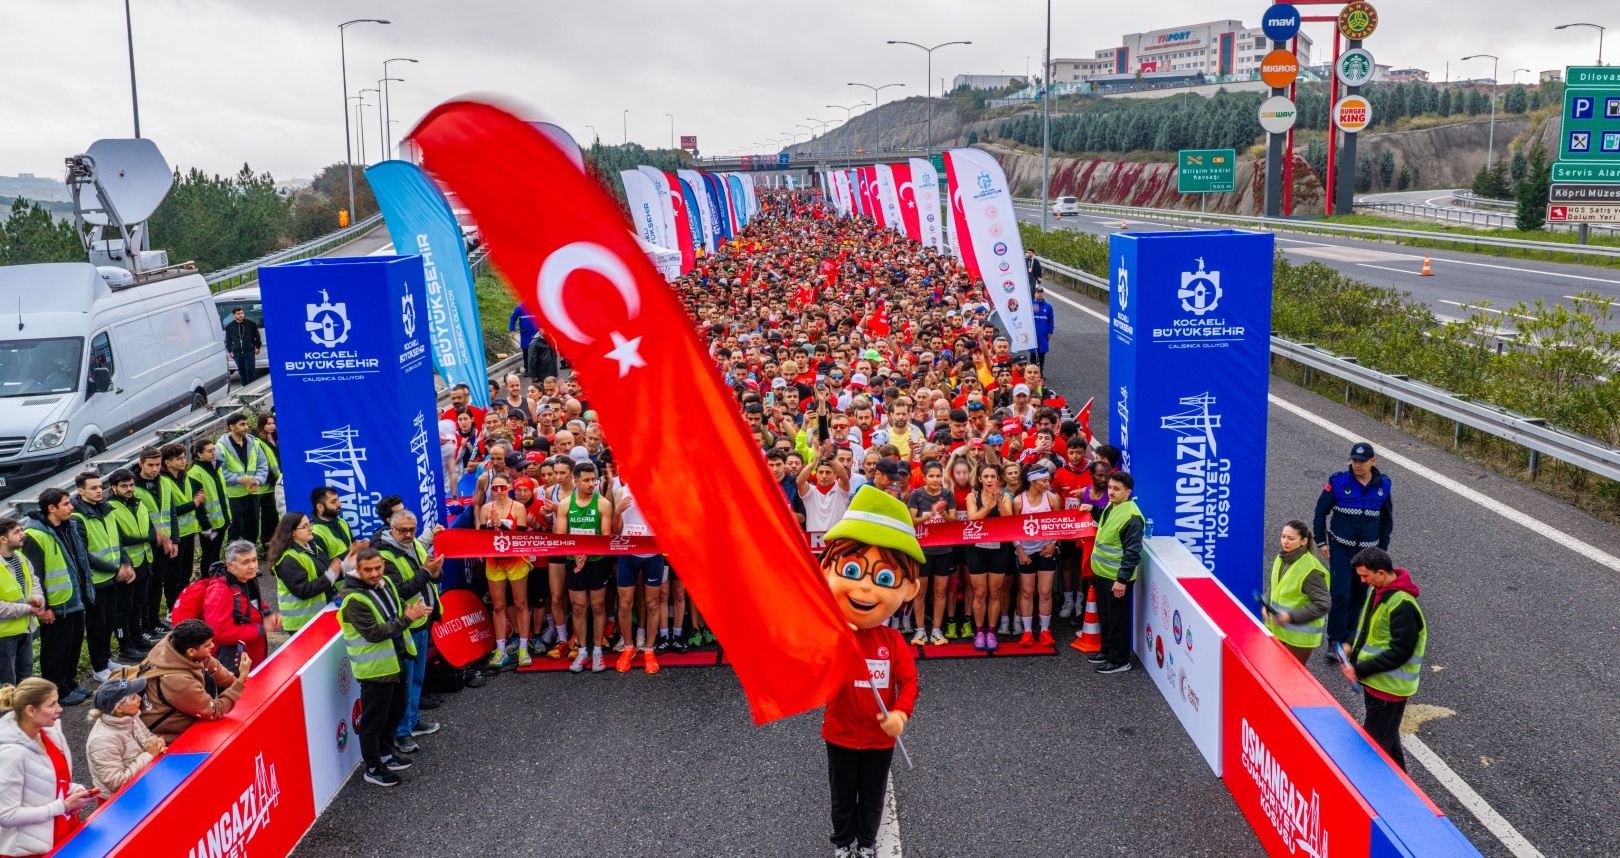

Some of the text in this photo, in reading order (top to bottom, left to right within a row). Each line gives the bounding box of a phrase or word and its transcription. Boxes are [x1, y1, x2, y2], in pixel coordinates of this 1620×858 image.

[1343, 4, 1374, 17] KAHVE
[1268, 16, 1295, 26] mavi
[1263, 64, 1296, 72] MIGROS
[1580, 73, 1620, 81] Dilovas
[1340, 114, 1366, 122] KING
[1558, 168, 1592, 176] Servis
[1555, 189, 1620, 198] Köprü Müzes
[1173, 318, 1225, 327] KOCAELİ
[1153, 326, 1245, 337] BÜYÜKŞEHİR
[304, 350, 358, 359] KOCAELİ
[285, 358, 379, 371] BÜYÜKŞEHİR
[1218, 458, 1231, 537] KOŞUSU
[1204, 459, 1218, 572] UMHURİYET
[1041, 521, 1094, 530] BÜYÜKŞEH
[434, 610, 485, 638] UNITED TIMING
